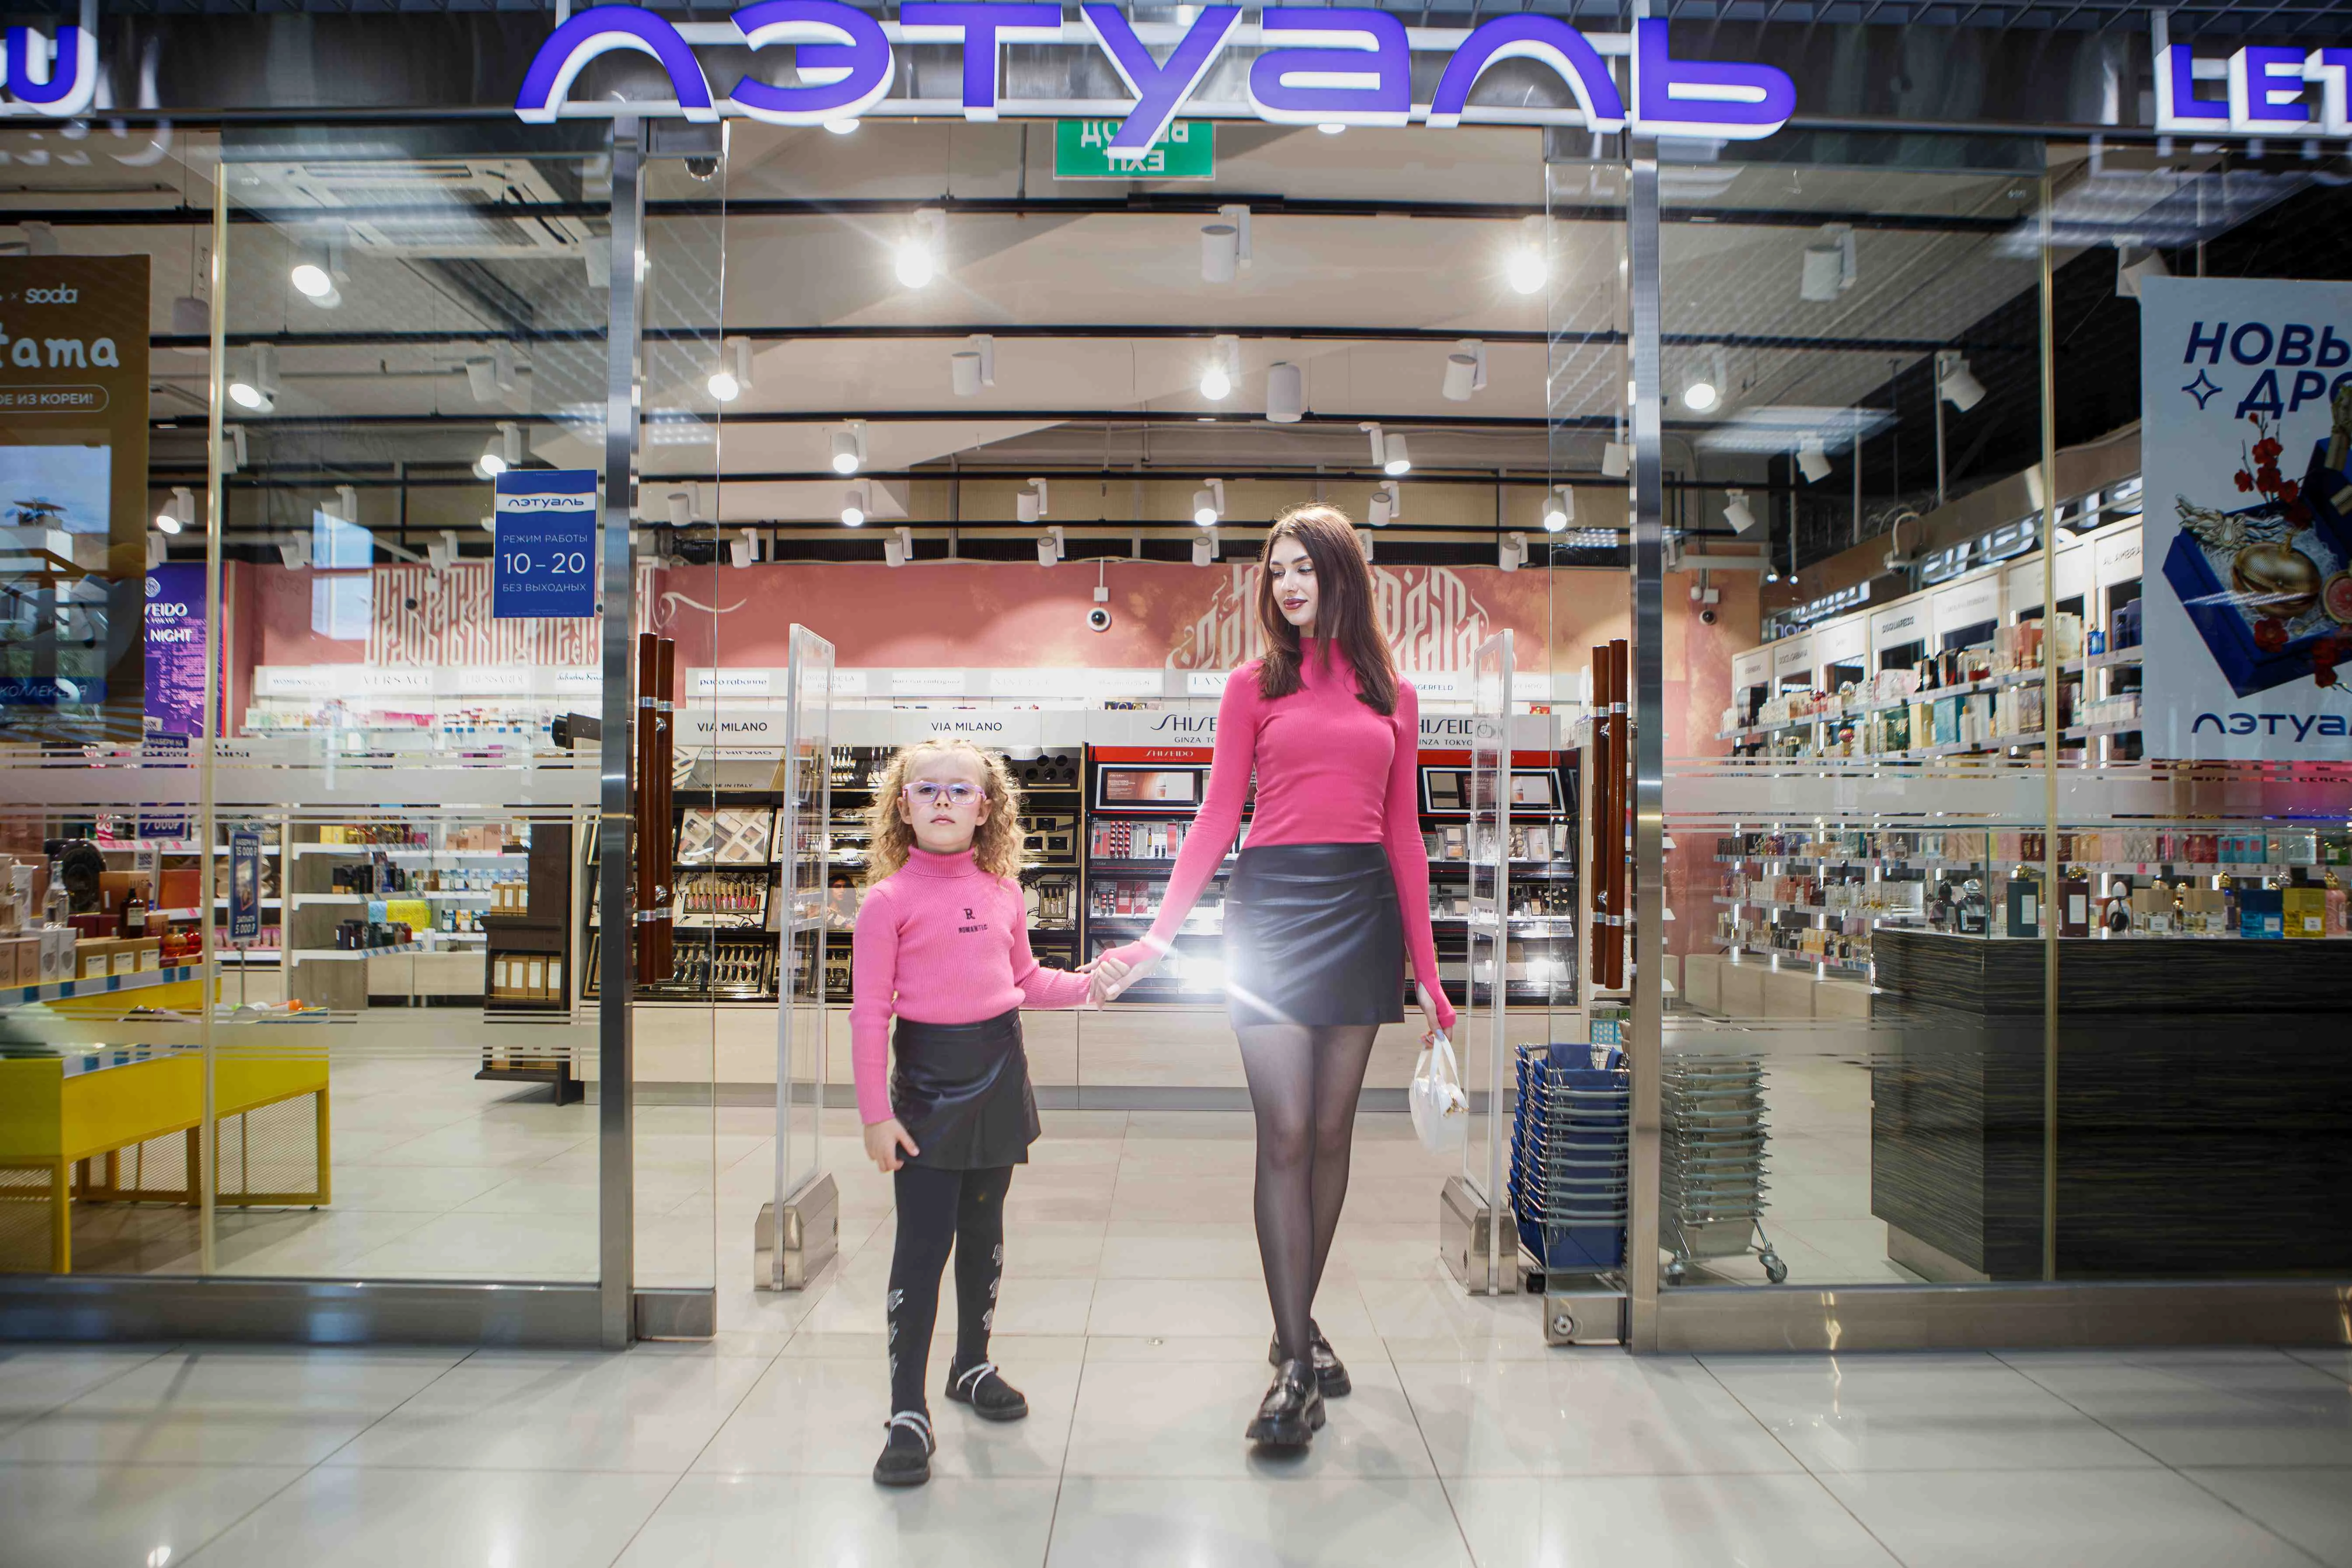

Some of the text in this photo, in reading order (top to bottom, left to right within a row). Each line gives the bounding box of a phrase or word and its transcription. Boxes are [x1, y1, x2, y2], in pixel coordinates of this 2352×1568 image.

[25, 283, 79, 304] soda
[17, 395, 37, 405] ИЗ
[503, 534, 587, 543] РЕЖИМ РАБОТЫ
[504, 553, 531, 574] 10
[551, 552, 586, 573] 20
[526, 583, 586, 592] ВЫХОДНЫХ
[150, 629, 192, 642] NIGHT
[0, 685, 87, 697] КОЛЛЕКЯ
[698, 723, 768, 731] VIA MILANO
[931, 722, 1002, 731] VIA MILANO
[1150, 714, 1218, 732] SHISE
[963, 908, 975, 919] R
[959, 924, 988, 933] ROMANTIC
